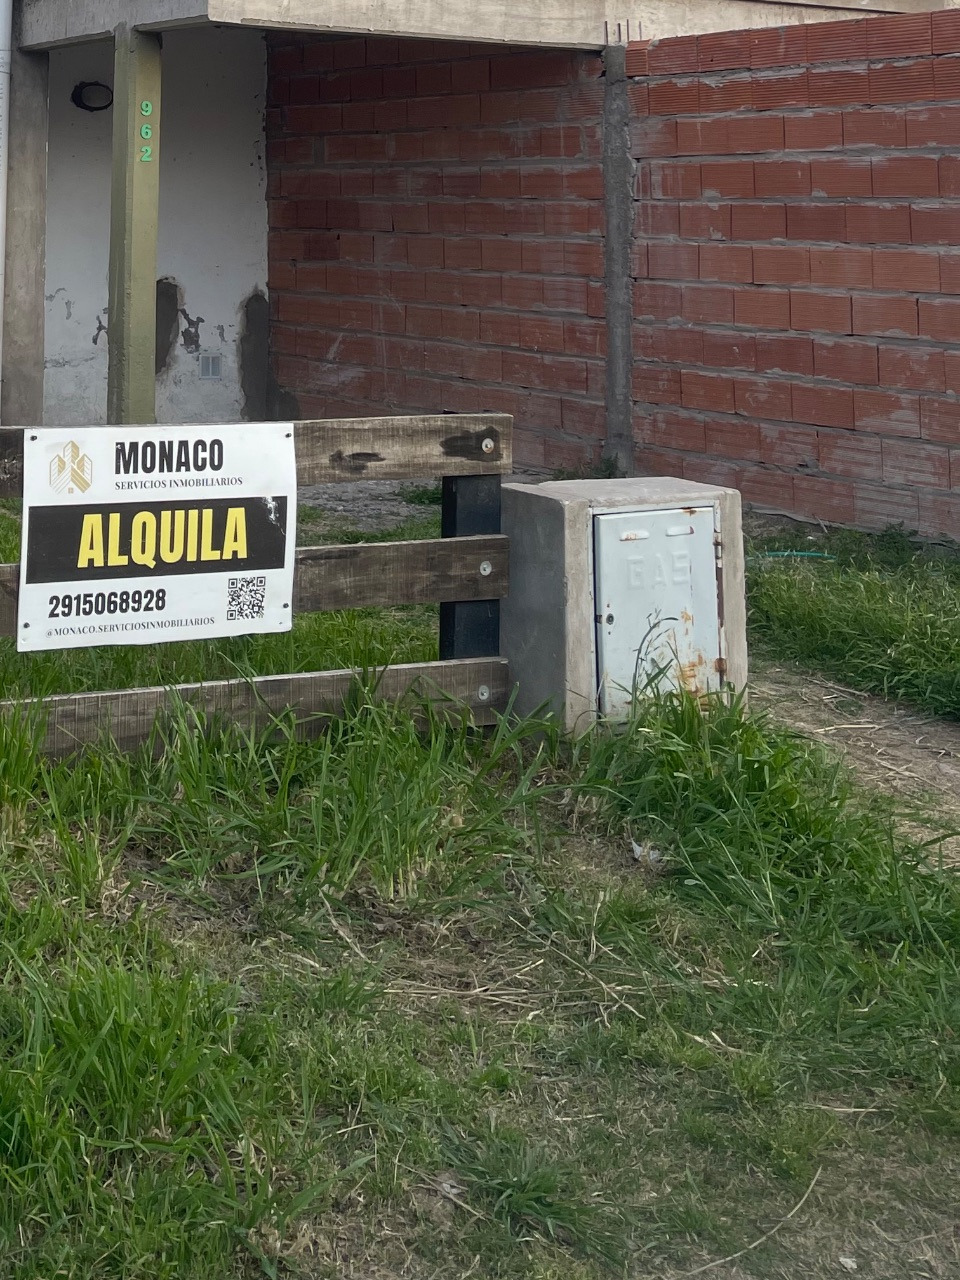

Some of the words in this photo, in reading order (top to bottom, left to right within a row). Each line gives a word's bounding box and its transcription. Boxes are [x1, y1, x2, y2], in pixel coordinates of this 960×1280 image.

[140, 100, 153, 162] 962
[115, 439, 224, 475] MONACO
[115, 479, 167, 490] SERVICIOS
[169, 477, 243, 488] INMOBILIARIOS
[77, 507, 248, 569] ALQUILA
[626, 550, 690, 590] GAS
[48, 588, 166, 618] 2915068928
[46, 617, 215, 638] @MONACO.SERVICIOSINMOBILIARIOS
